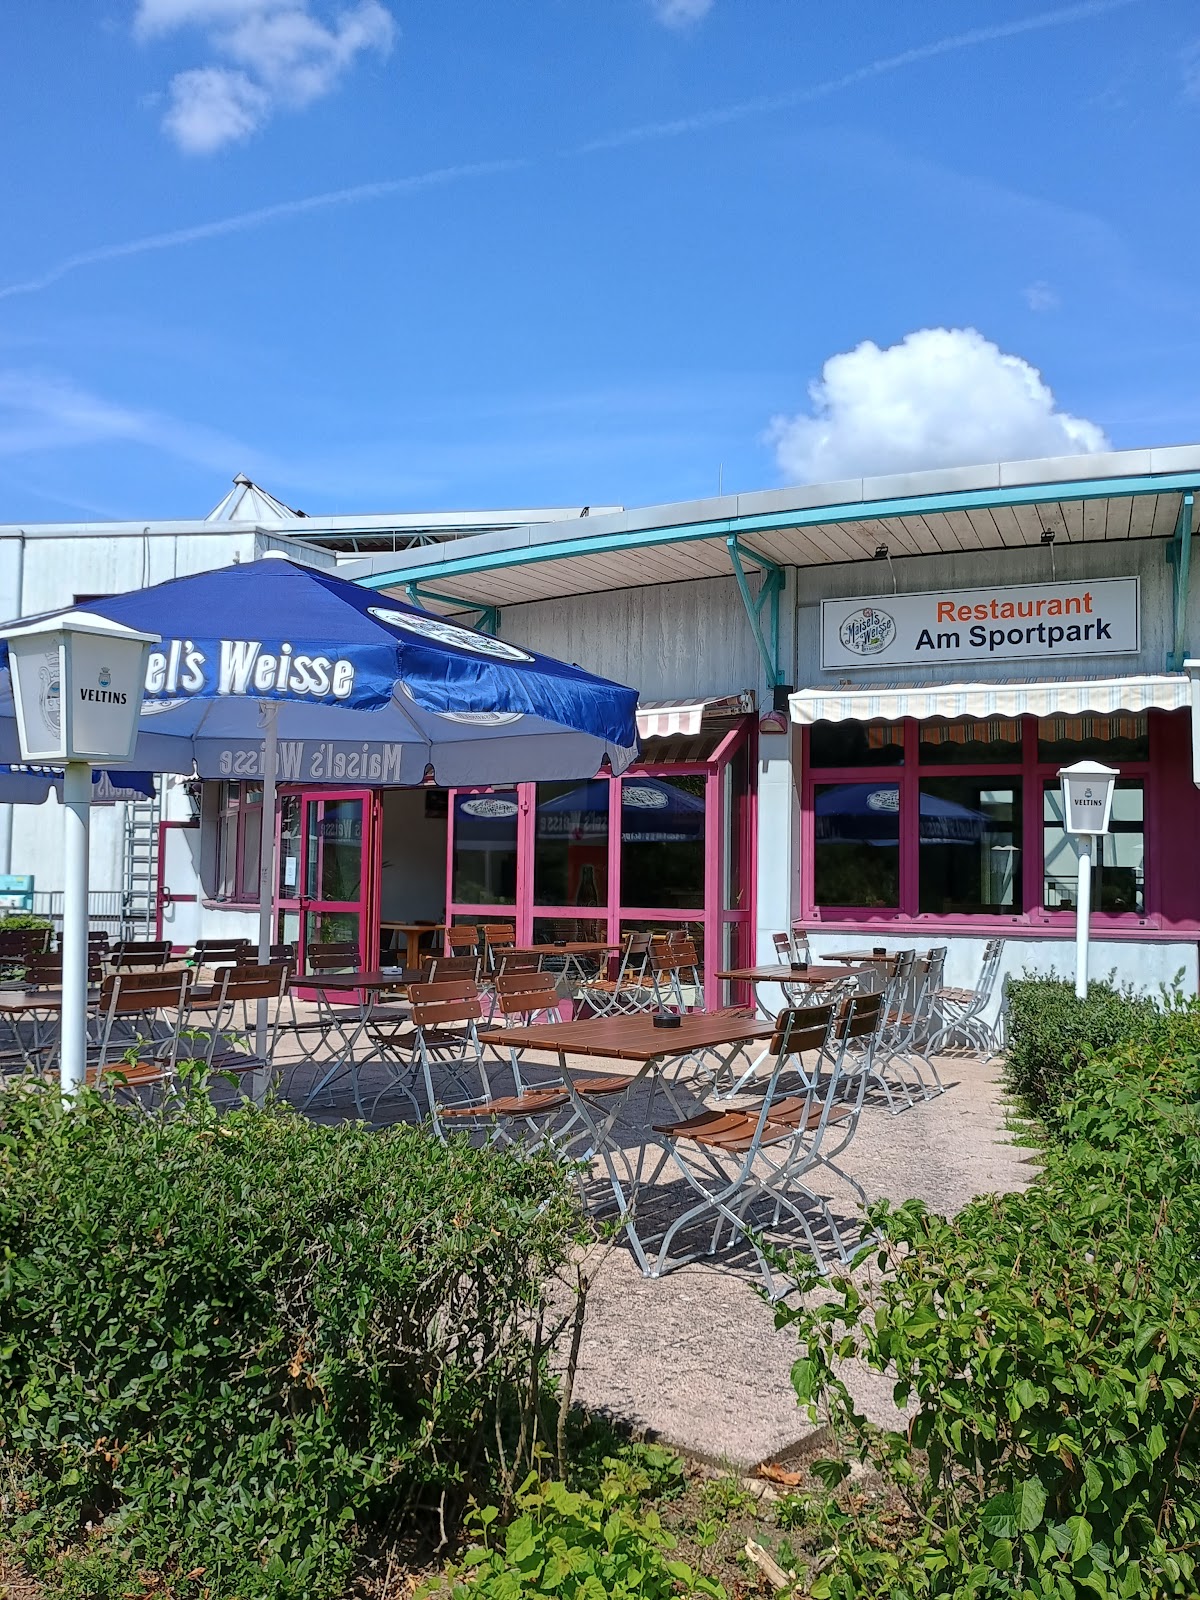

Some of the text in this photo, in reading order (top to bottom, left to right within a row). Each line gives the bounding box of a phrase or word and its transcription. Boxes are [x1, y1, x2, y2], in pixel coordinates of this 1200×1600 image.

[937, 591, 1093, 623] Restaurant
[861, 618, 892, 645] Weisse
[915, 629, 960, 651] Am
[969, 618, 1112, 651] Sportpark
[145, 639, 354, 699] el's Weisse
[80, 688, 127, 705] VELTINS
